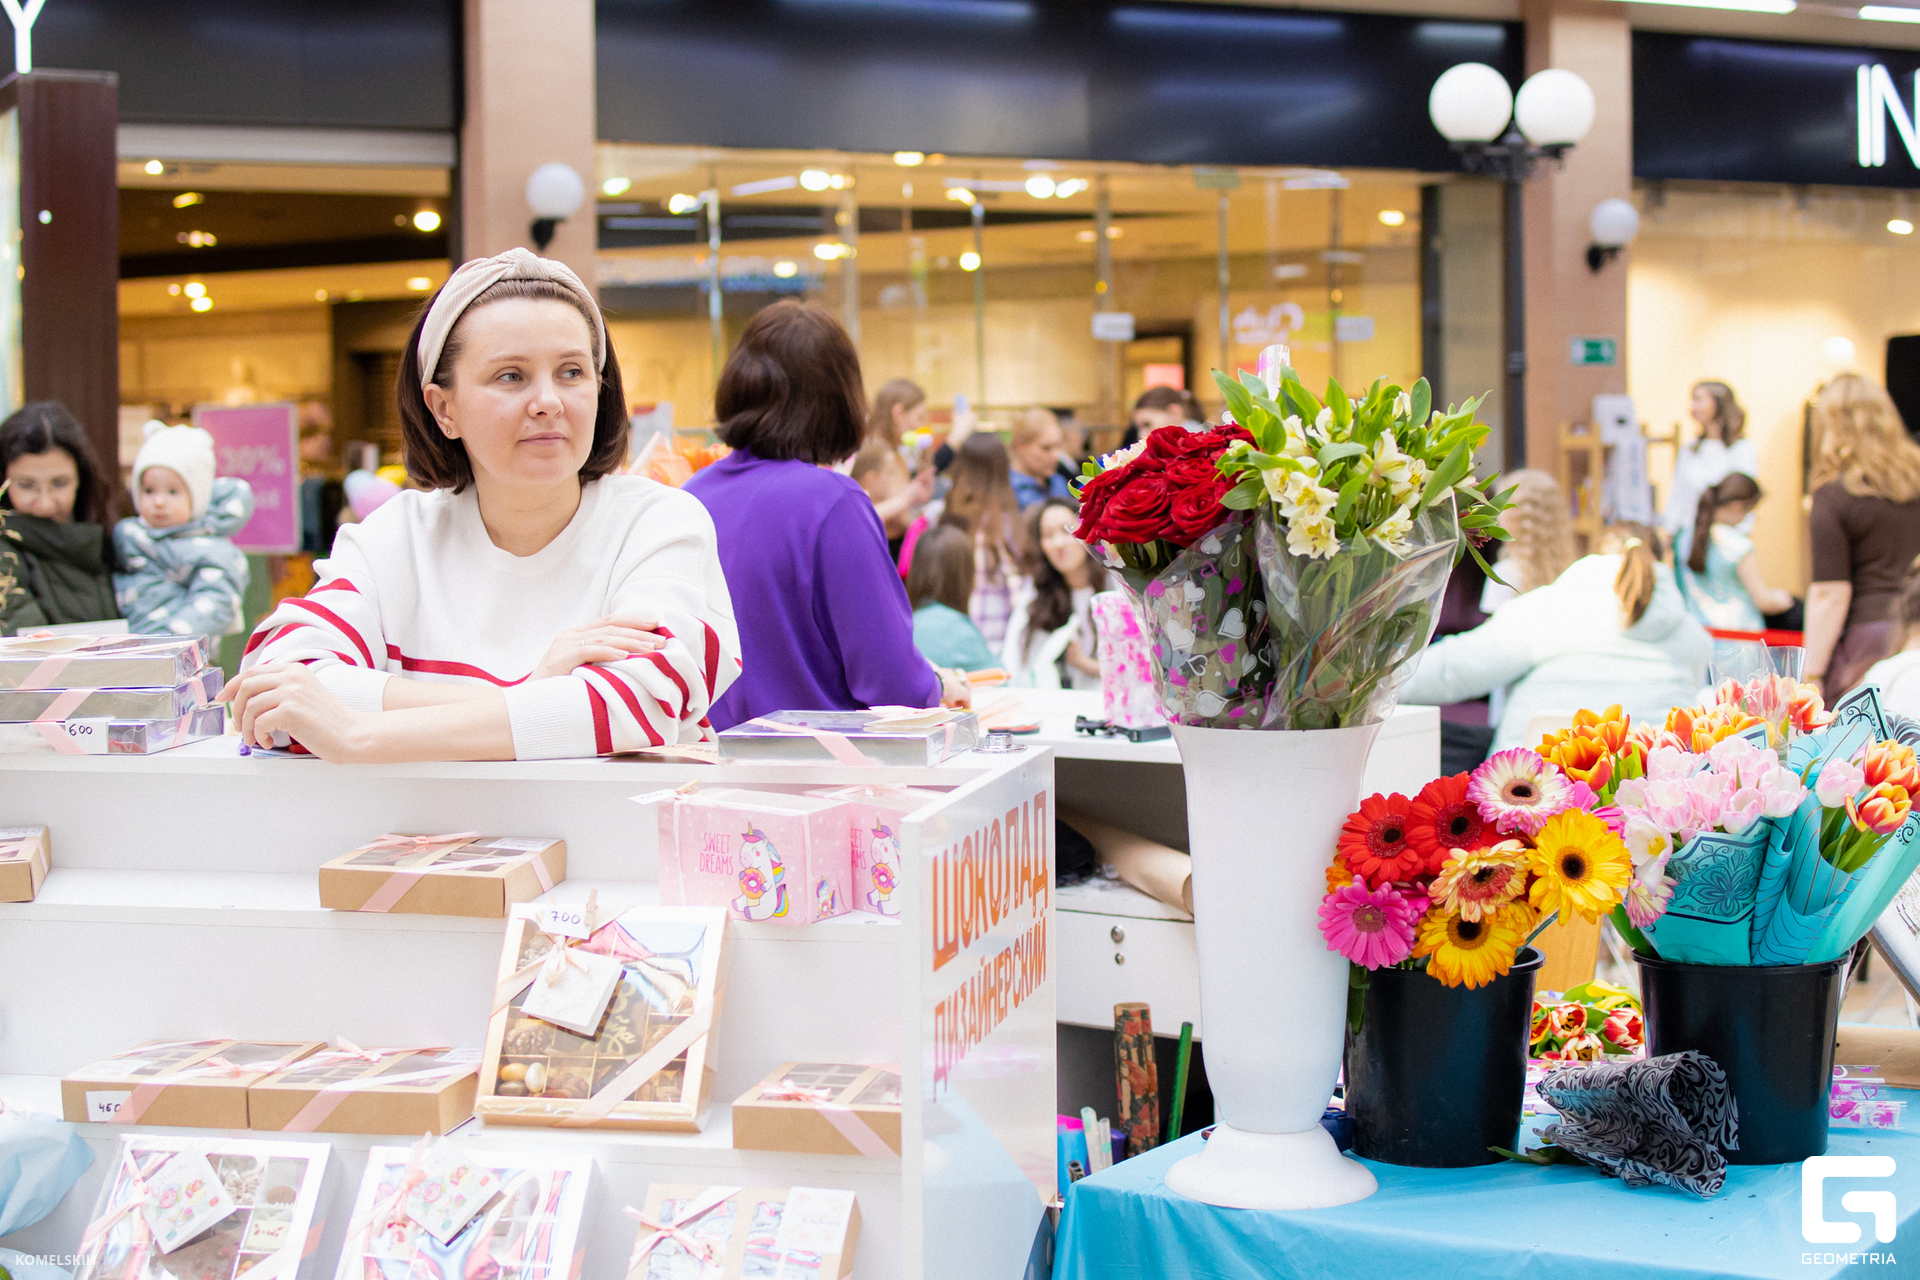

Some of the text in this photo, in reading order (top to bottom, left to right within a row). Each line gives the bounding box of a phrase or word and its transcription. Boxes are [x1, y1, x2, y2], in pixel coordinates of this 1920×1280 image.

[0, 0, 47, 75] Y
[68, 723, 93, 737] 600
[703, 832, 731, 855] SWEET
[699, 852, 734, 876] DREAMS
[933, 790, 1048, 973] ШОКОЛАД
[551, 910, 581, 925] 700
[933, 906, 1046, 1104] ДИЗАЙНЕРСКИЙ
